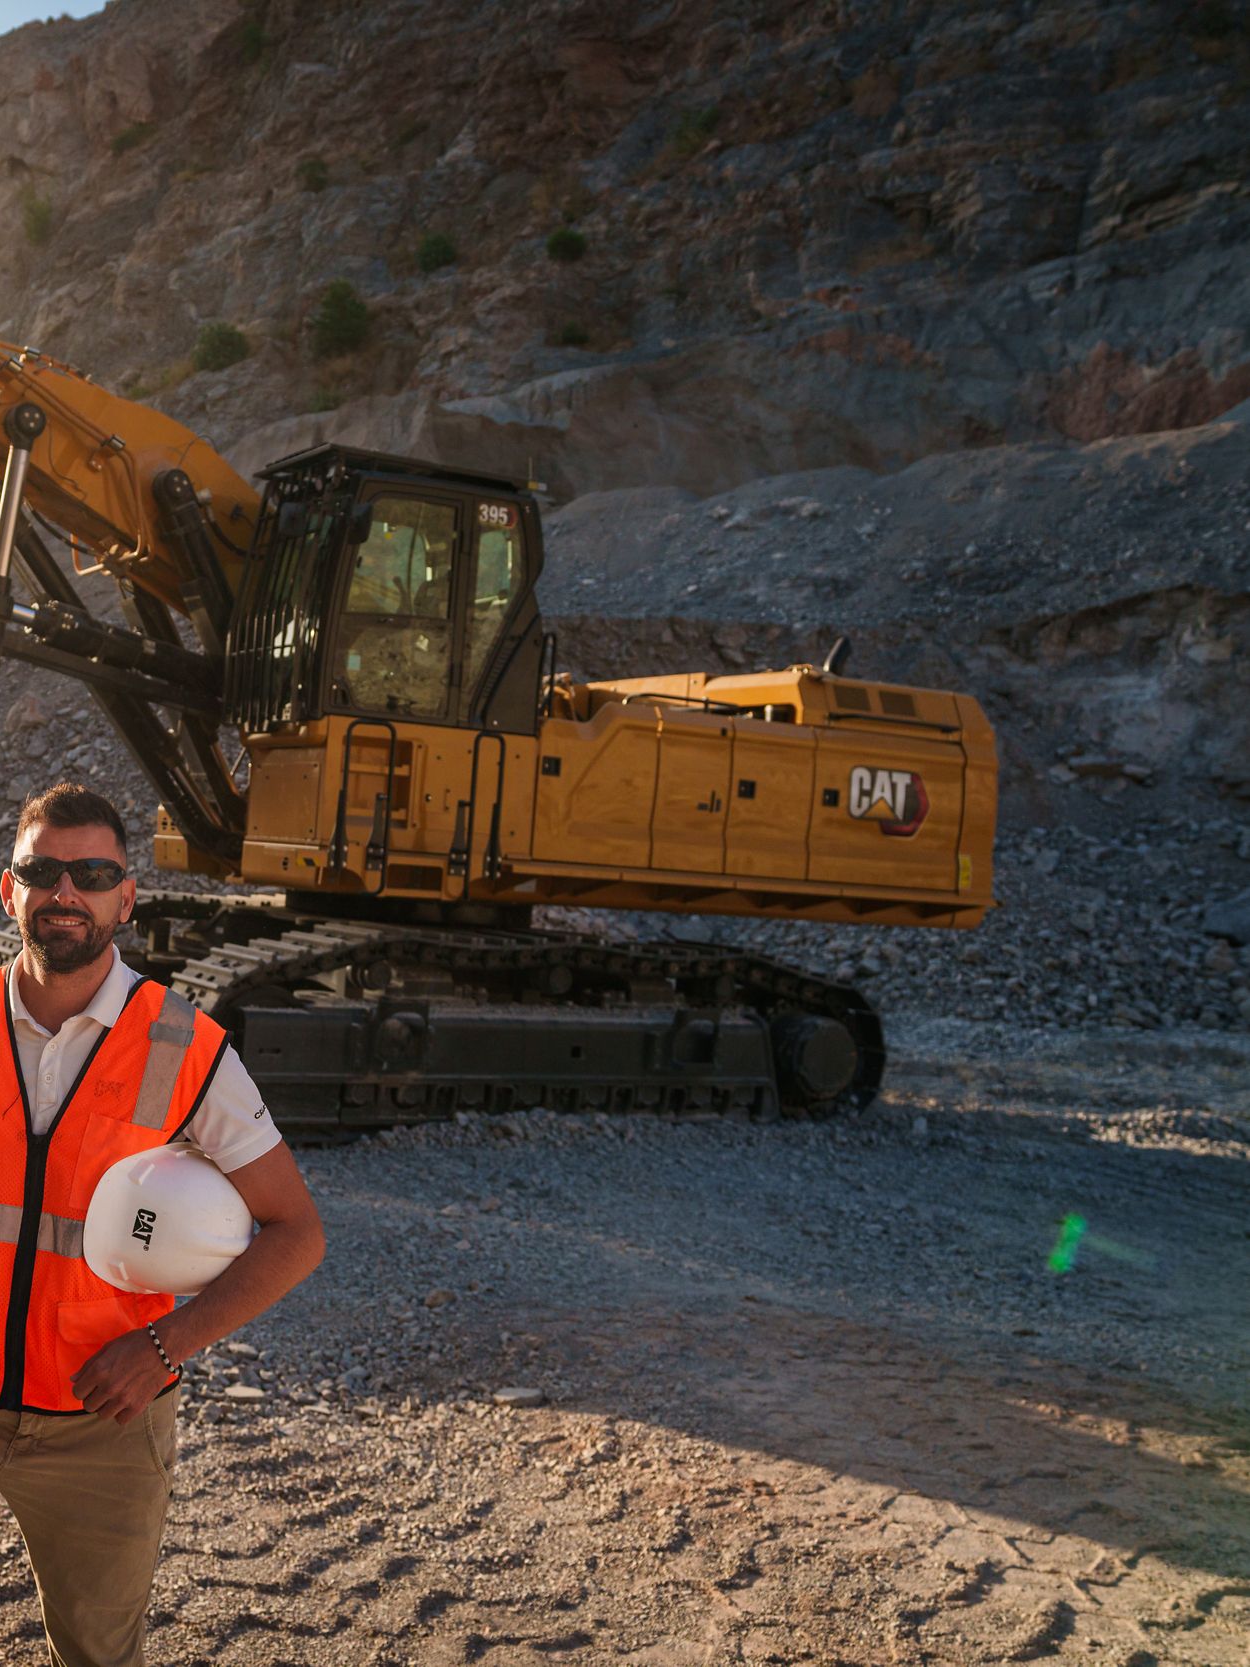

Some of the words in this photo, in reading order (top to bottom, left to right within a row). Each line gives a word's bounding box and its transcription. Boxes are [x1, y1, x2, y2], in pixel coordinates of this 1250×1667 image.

[479, 504, 508, 525] 395
[850, 766, 911, 821] CAT
[132, 1208, 156, 1246] CAT
